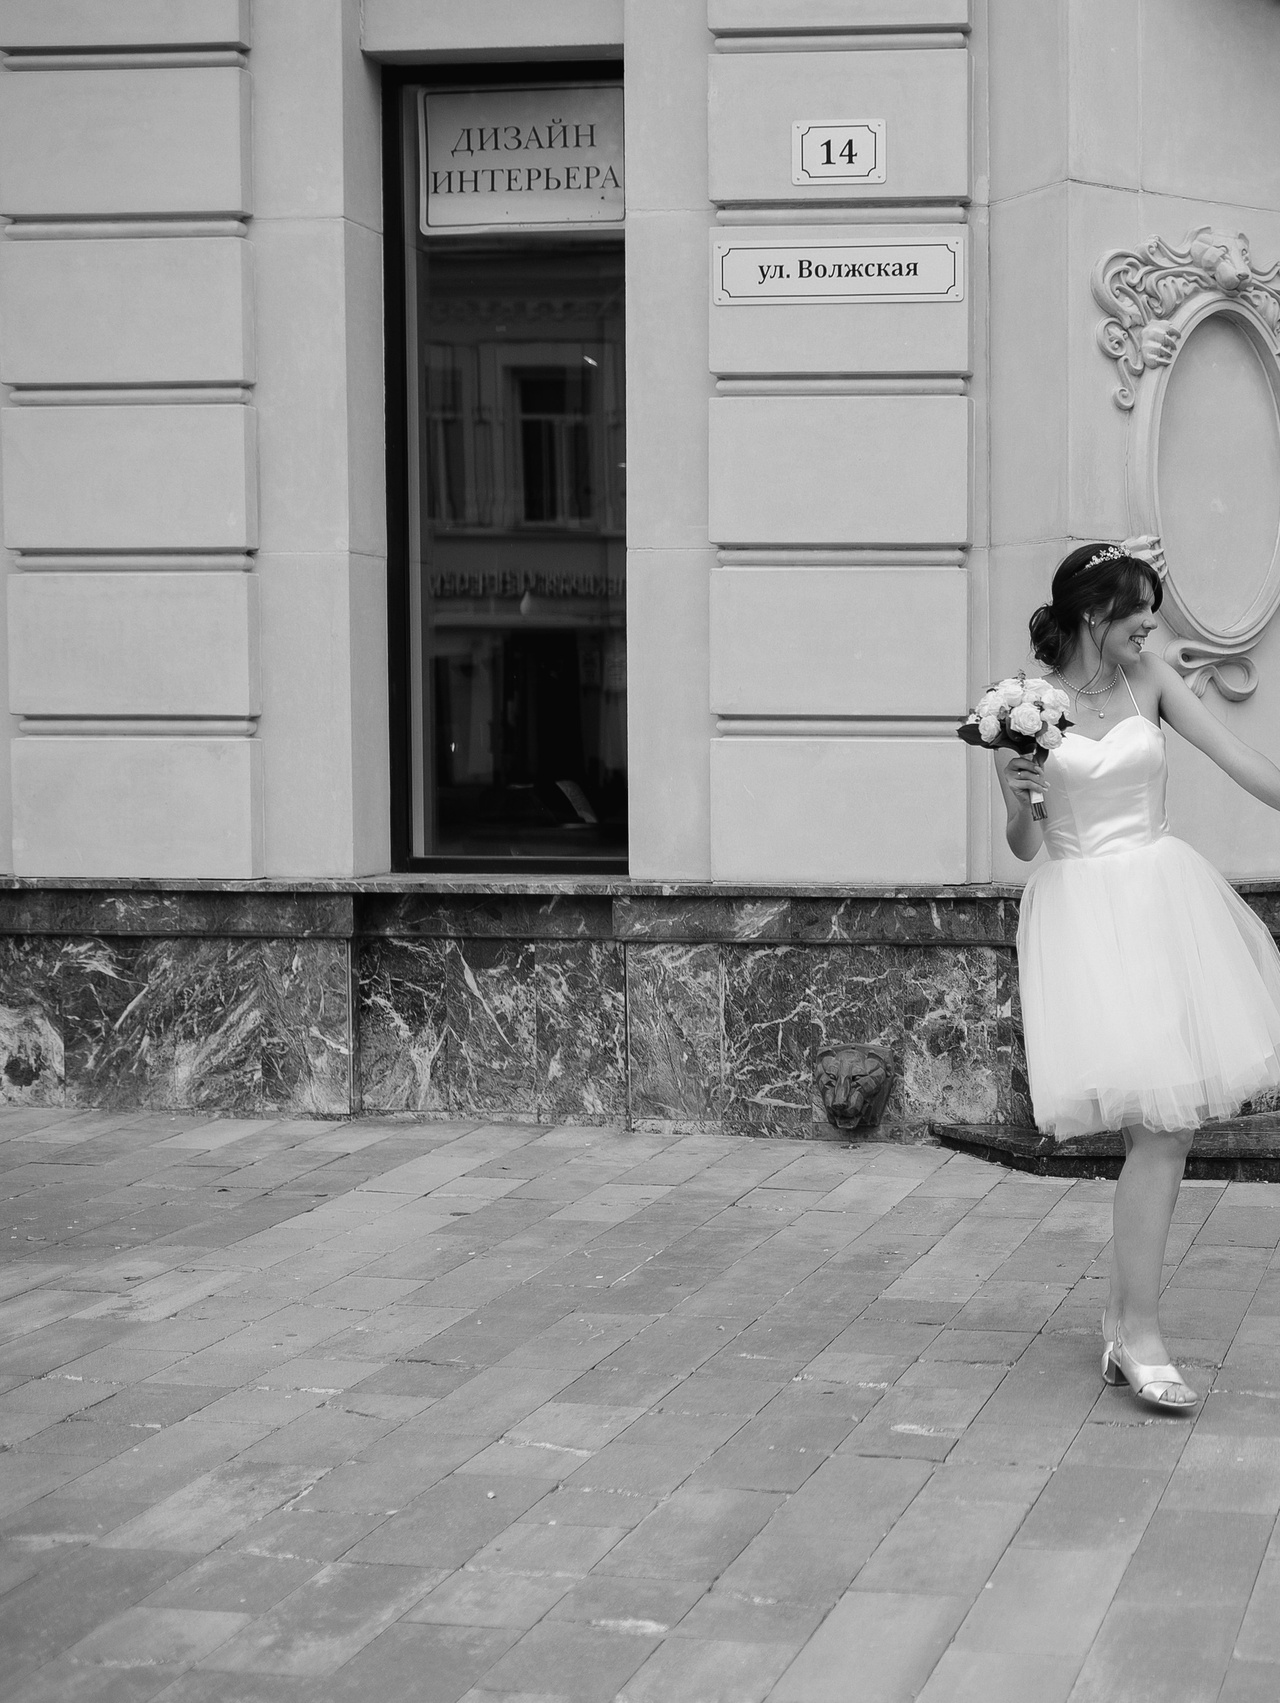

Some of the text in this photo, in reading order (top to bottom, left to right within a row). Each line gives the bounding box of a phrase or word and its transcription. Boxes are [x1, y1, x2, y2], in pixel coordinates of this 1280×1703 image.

[450, 118, 597, 156] ДИЗАЙН
[820, 139, 858, 166] 14
[430, 165, 622, 195] ИНТЕРЬЕРА
[757, 258, 919, 283] ул. Волжская
